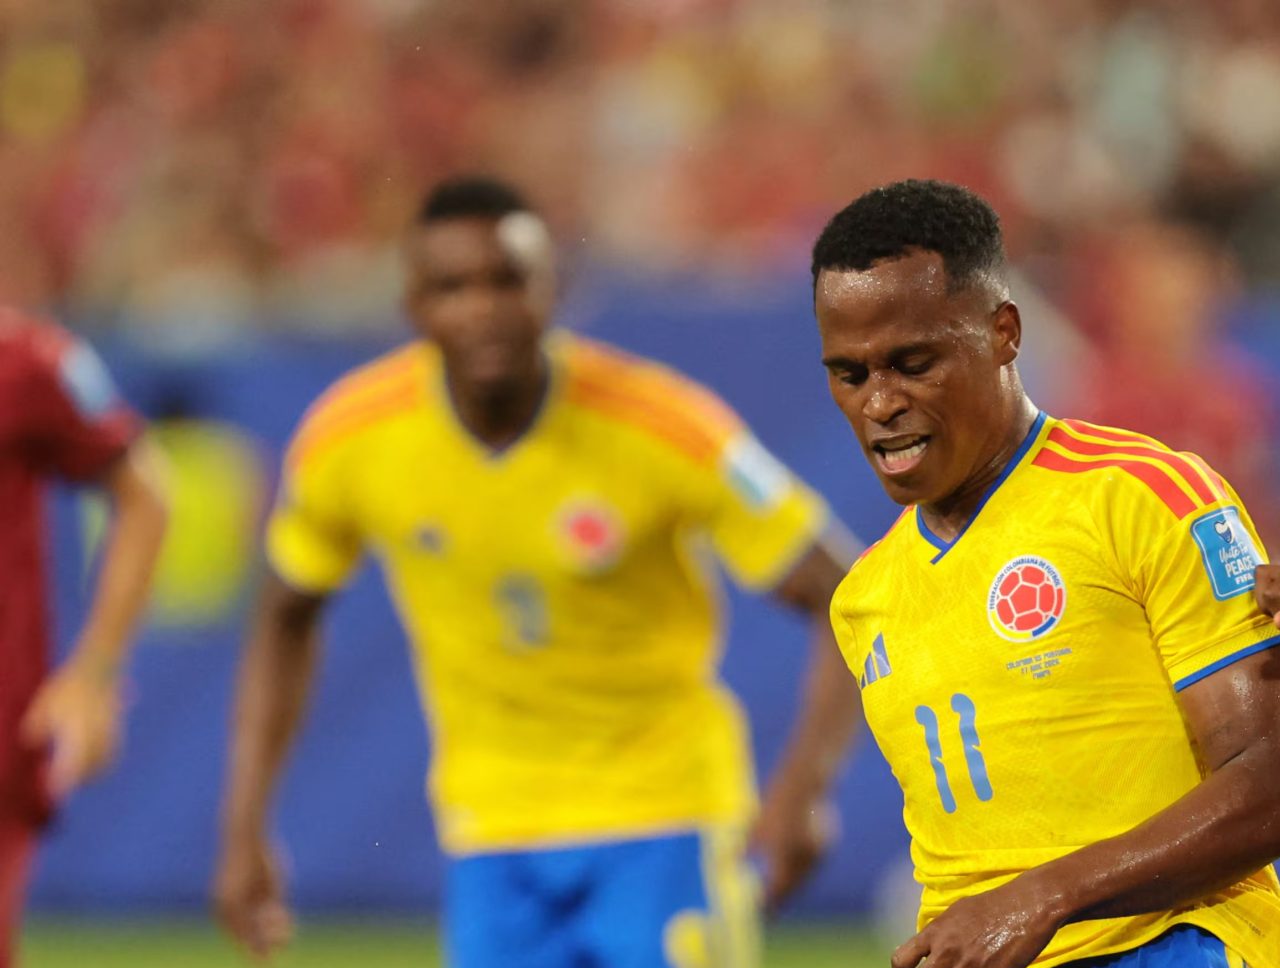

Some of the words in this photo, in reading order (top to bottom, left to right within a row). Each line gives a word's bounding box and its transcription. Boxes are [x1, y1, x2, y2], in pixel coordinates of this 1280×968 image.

[1224, 555, 1256, 578] PEACE
[1234, 573, 1254, 584] FIFA
[914, 692, 994, 814] 11
